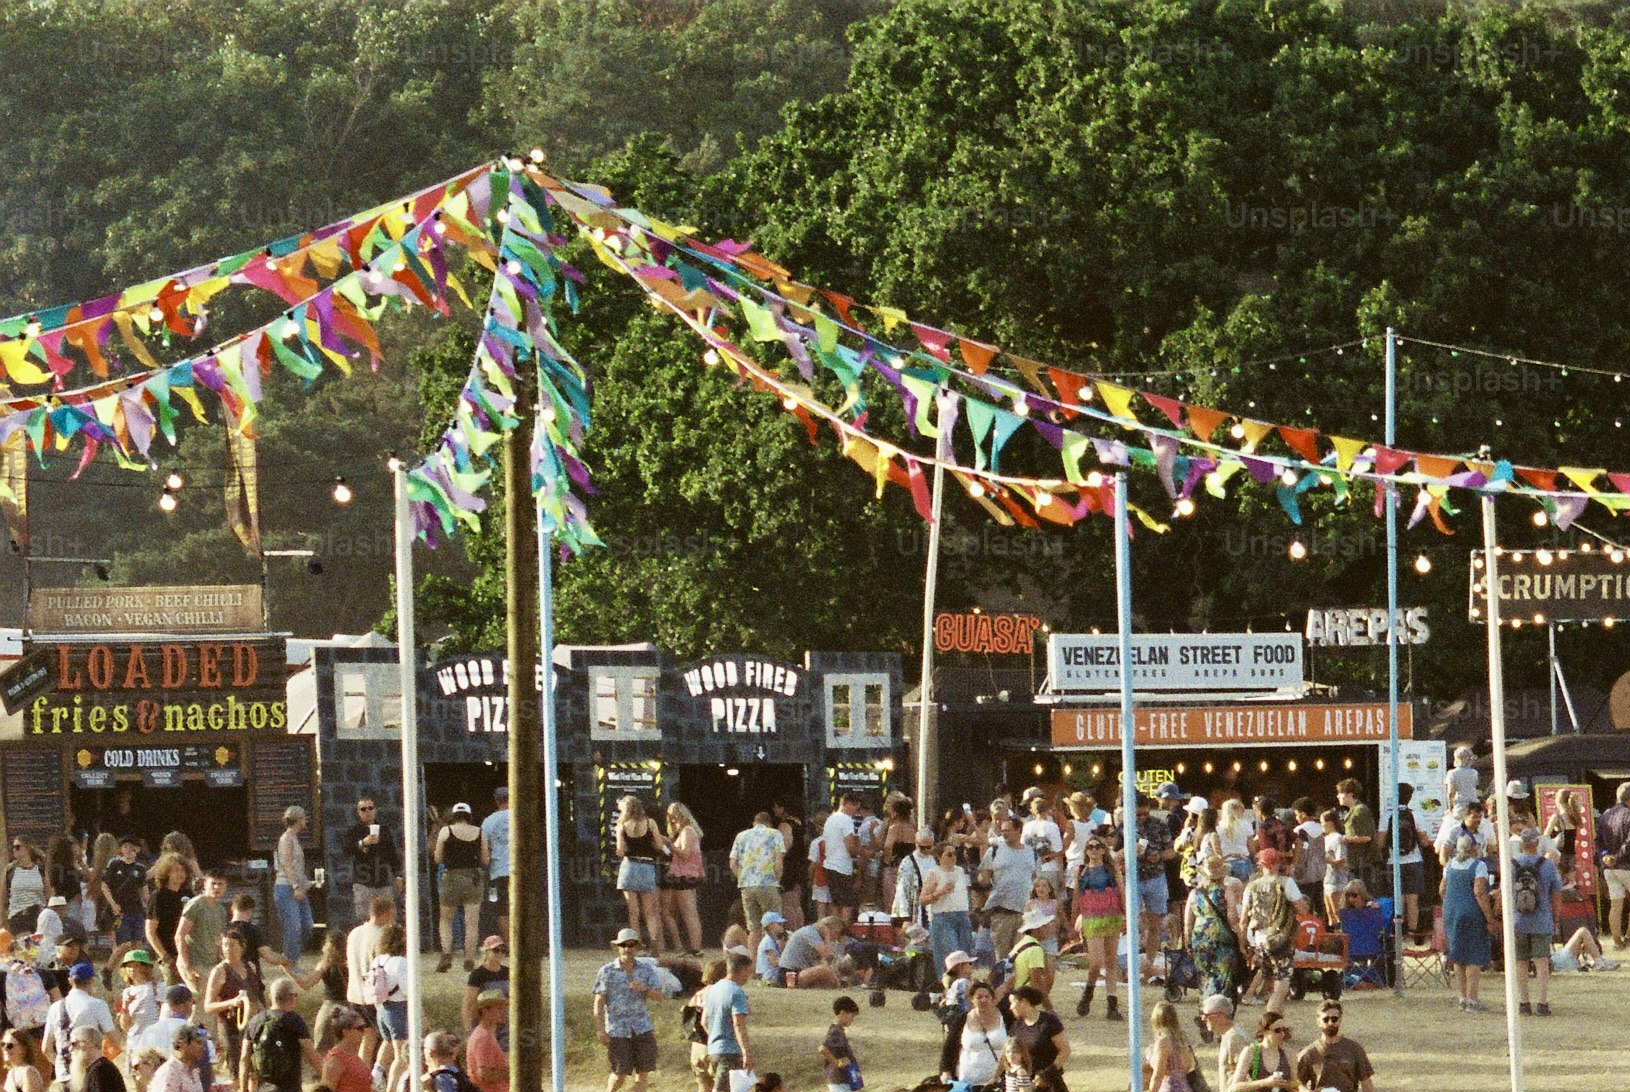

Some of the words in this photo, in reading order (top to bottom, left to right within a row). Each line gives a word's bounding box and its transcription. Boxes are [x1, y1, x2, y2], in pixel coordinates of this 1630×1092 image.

[47, 596, 105, 610] PULLED
[106, 595, 145, 609] PORK
[155, 594, 191, 607] BEEF
[195, 593, 243, 607] CHILLI
[64, 614, 113, 627] BACON
[124, 612, 174, 626] VEGAN
[175, 611, 224, 625] CHILLI
[1305, 606, 1430, 647] AREPAS
[57, 643, 258, 690] LOADED
[1062, 645, 1169, 667] VENEZELAN
[1180, 644, 1242, 665] STREET
[1253, 643, 1296, 664] FOOD
[436, 659, 495, 696] WOOD
[684, 660, 738, 698] WOOD
[745, 660, 798, 697] FIRED
[31, 694, 129, 735] fries
[136, 699, 160, 735] &
[163, 695, 286, 732] nachos
[466, 696, 509, 733] PIZ
[710, 697, 777, 734] PIZZA
[1075, 711, 1188, 741] GLUTE-FREE
[1204, 708, 1308, 738] VENEZUELAN
[1323, 706, 1386, 735] AREPAS
[104, 749, 133, 768] COLD
[137, 748, 181, 767] DRINKS
